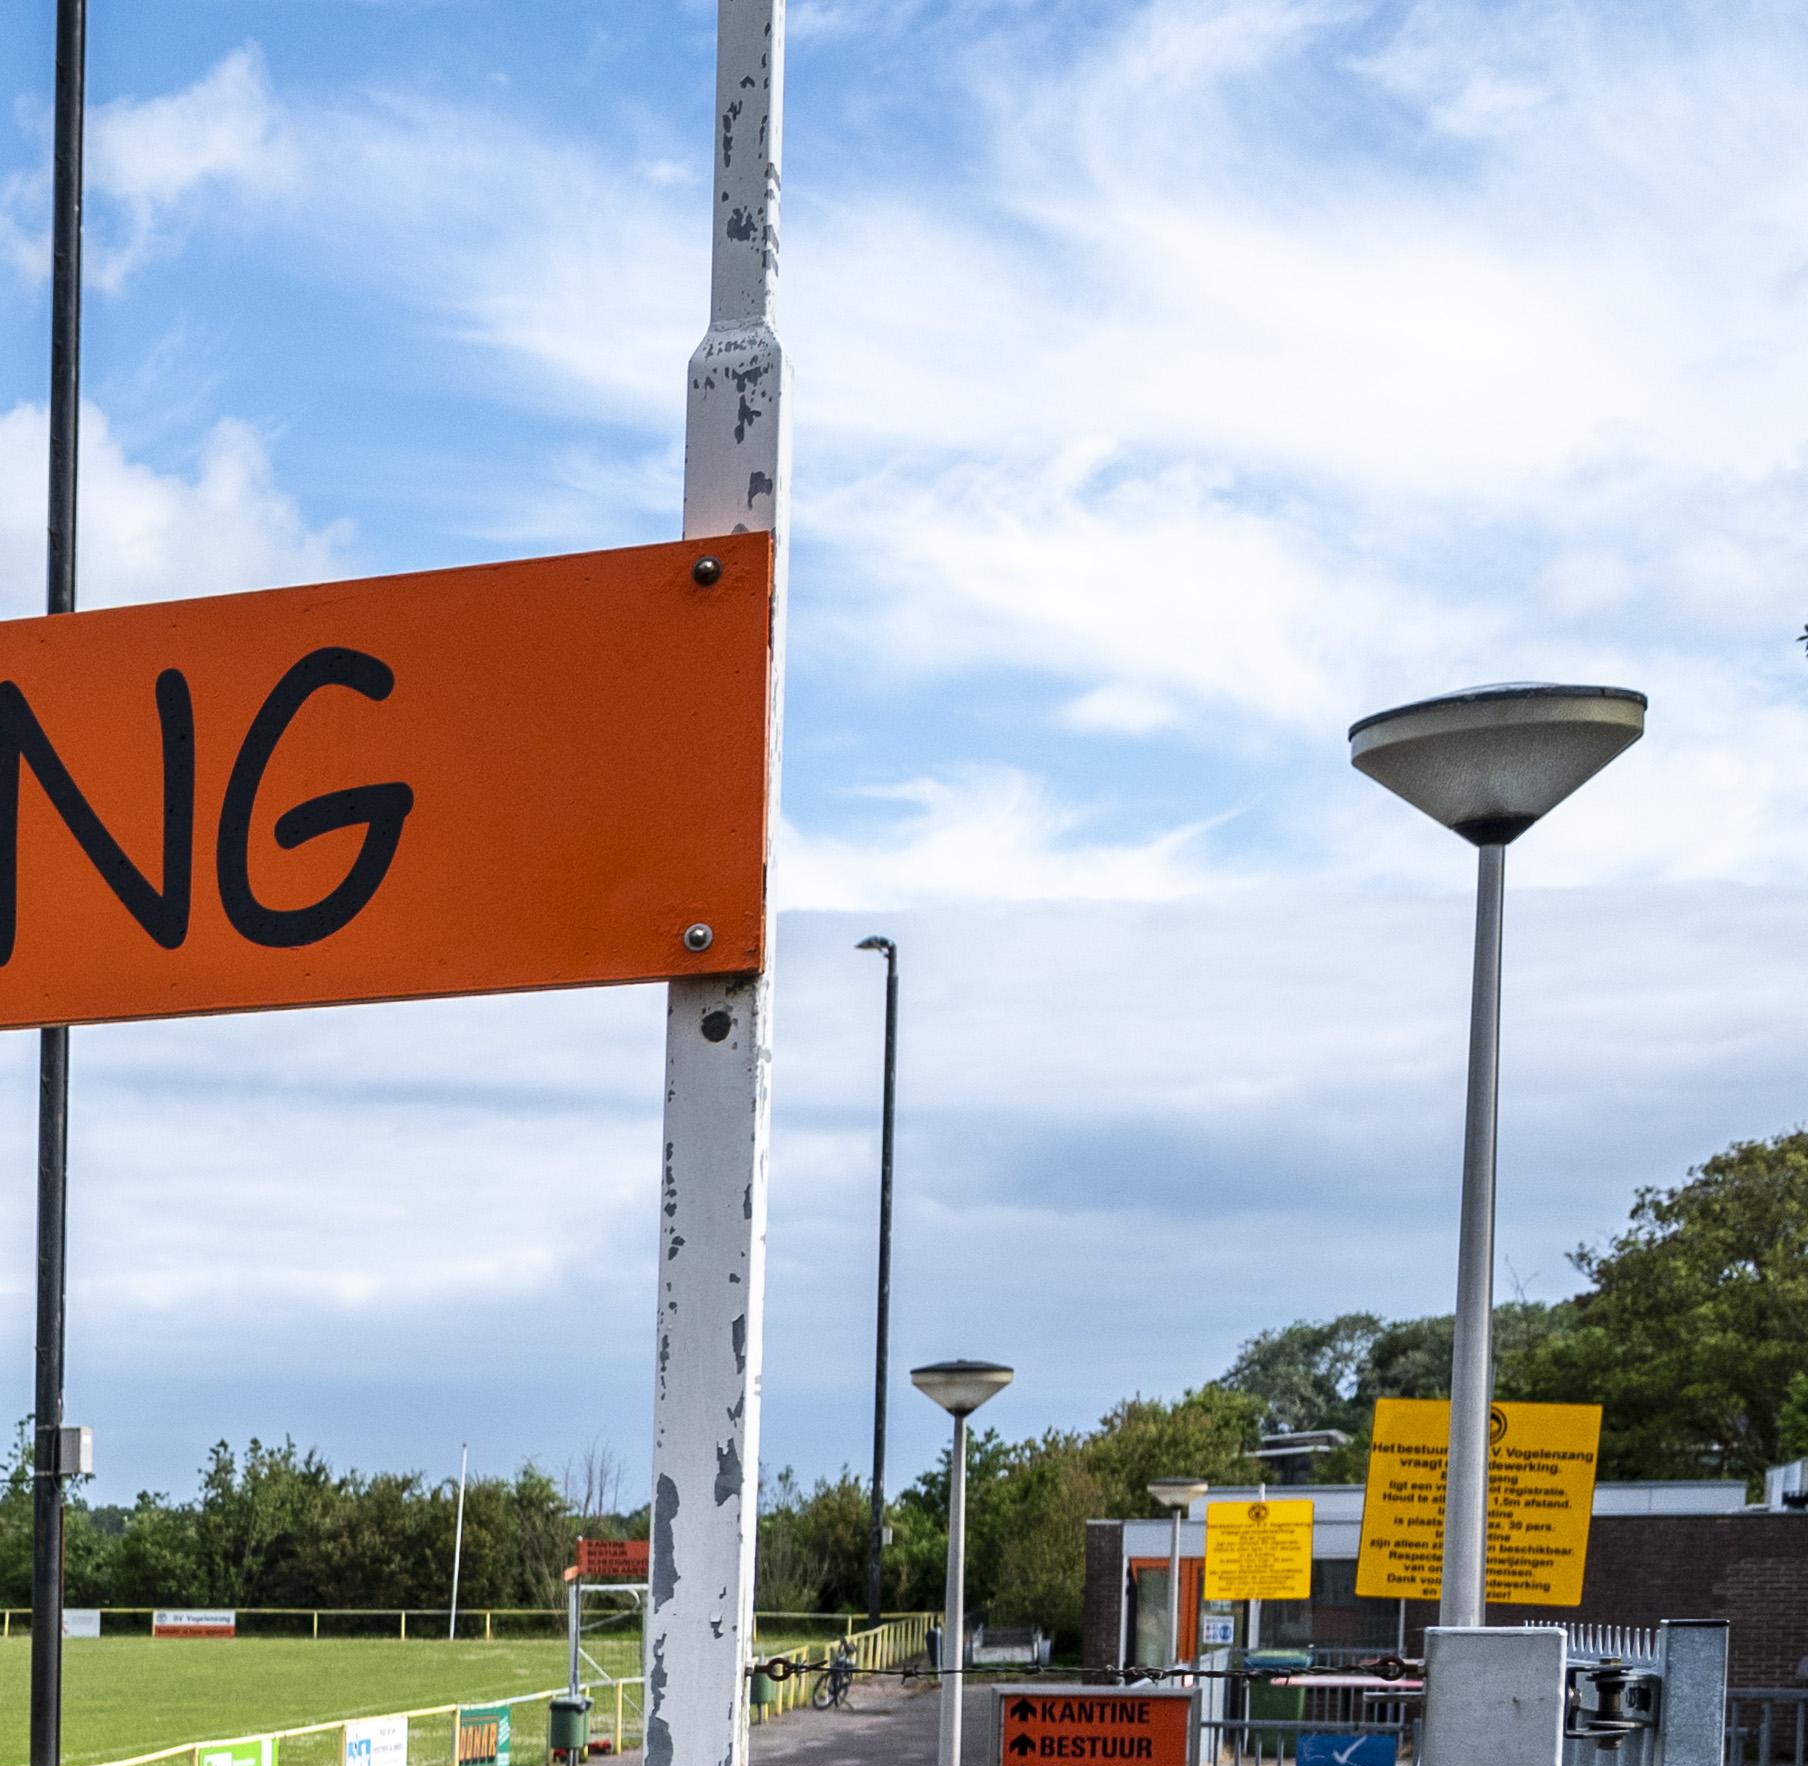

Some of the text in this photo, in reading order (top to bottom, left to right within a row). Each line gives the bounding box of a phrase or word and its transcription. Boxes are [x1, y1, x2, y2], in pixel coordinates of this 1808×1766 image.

[1373, 1442, 1395, 1453] Het
[1506, 1447, 1594, 1463] Vogelenzang
[1488, 1460, 1562, 1475] dewerking.
[1388, 1550, 1444, 1562] Respecte
[1041, 1701, 1151, 1724] KANTINE
[1039, 1736, 1152, 1759] BESTUUR
